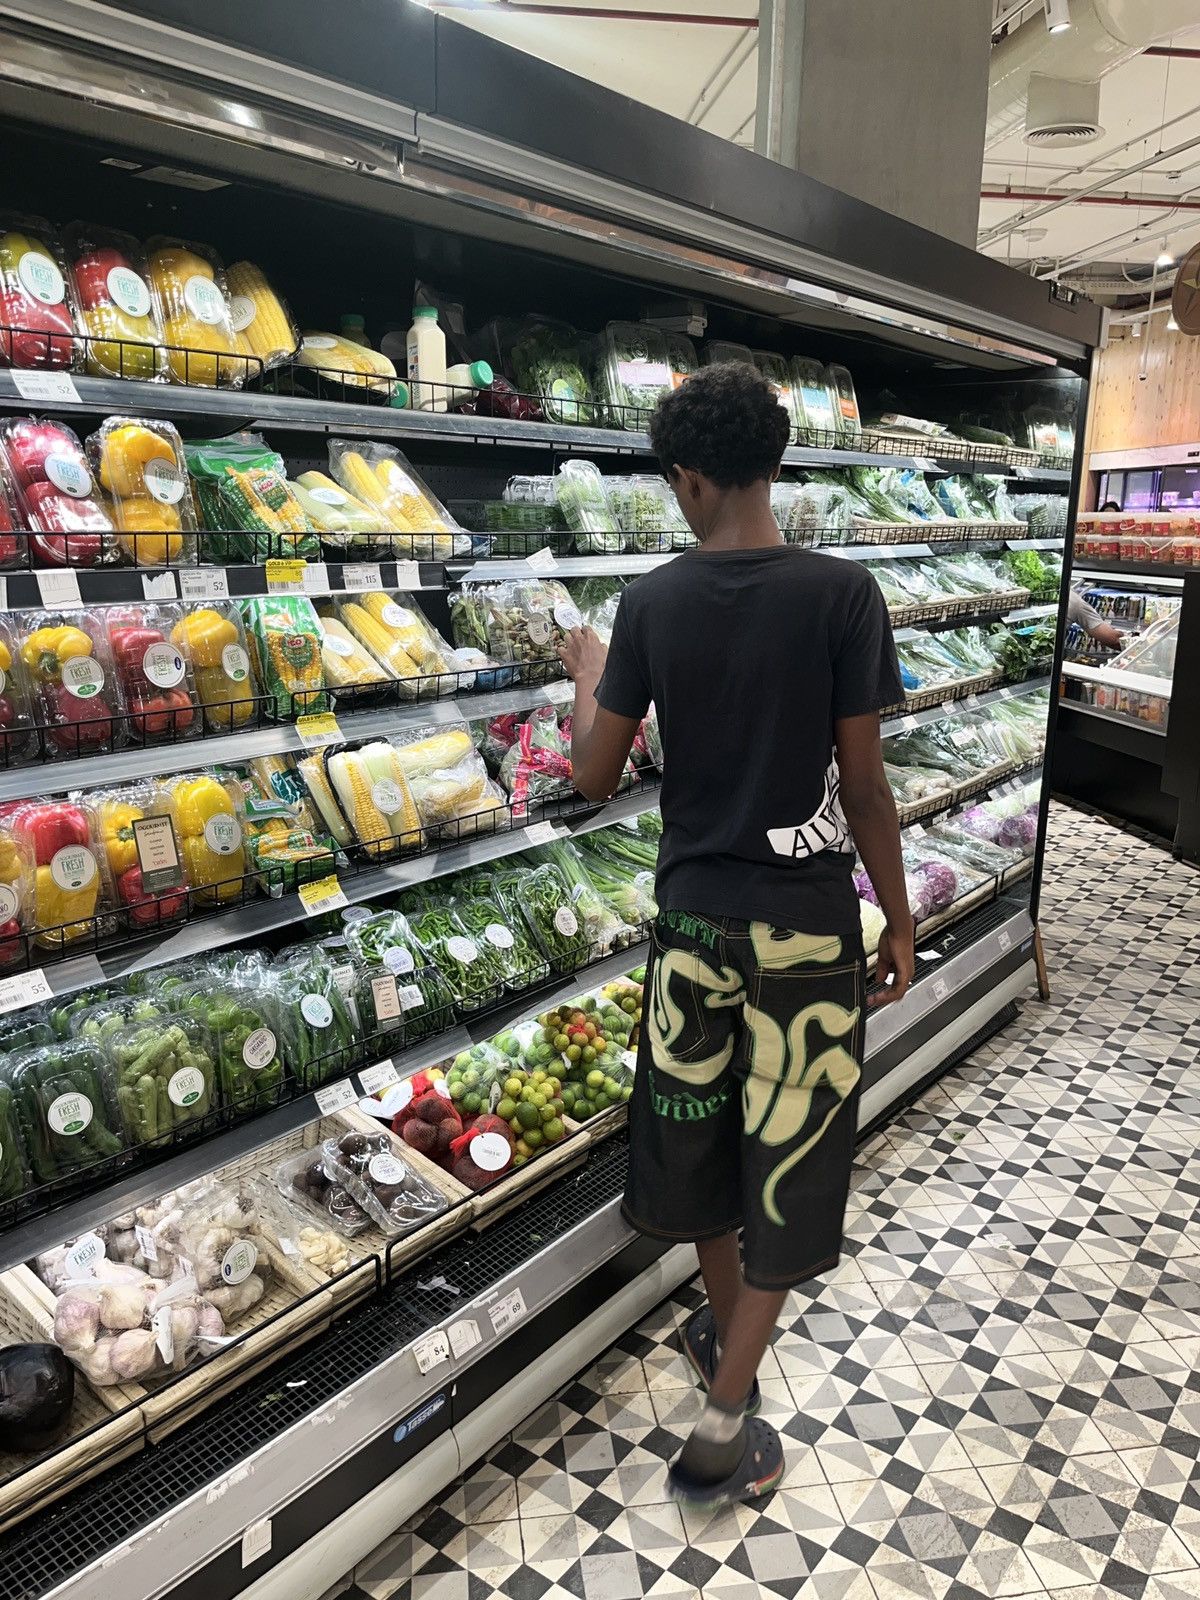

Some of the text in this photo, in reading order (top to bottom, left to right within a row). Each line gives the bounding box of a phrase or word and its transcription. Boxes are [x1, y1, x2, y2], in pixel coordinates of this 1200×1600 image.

[58, 385, 72, 395] 52
[57, 463, 80, 480] FRESH
[365, 575, 377, 584] 115
[213, 581, 225, 591] 52
[70, 667, 91, 679] FRESH
[213, 826, 233, 837] FRESH
[61, 857, 85, 873] FRESH
[32, 983, 47, 995] 55
[176, 1076, 195, 1091] FRESH
[342, 1089, 352, 1100] 52
[58, 1102, 81, 1117] FRESH
[74, 1245, 96, 1265] FRESH
[511, 1302, 521, 1314] 69
[434, 1345, 445, 1356] 84
